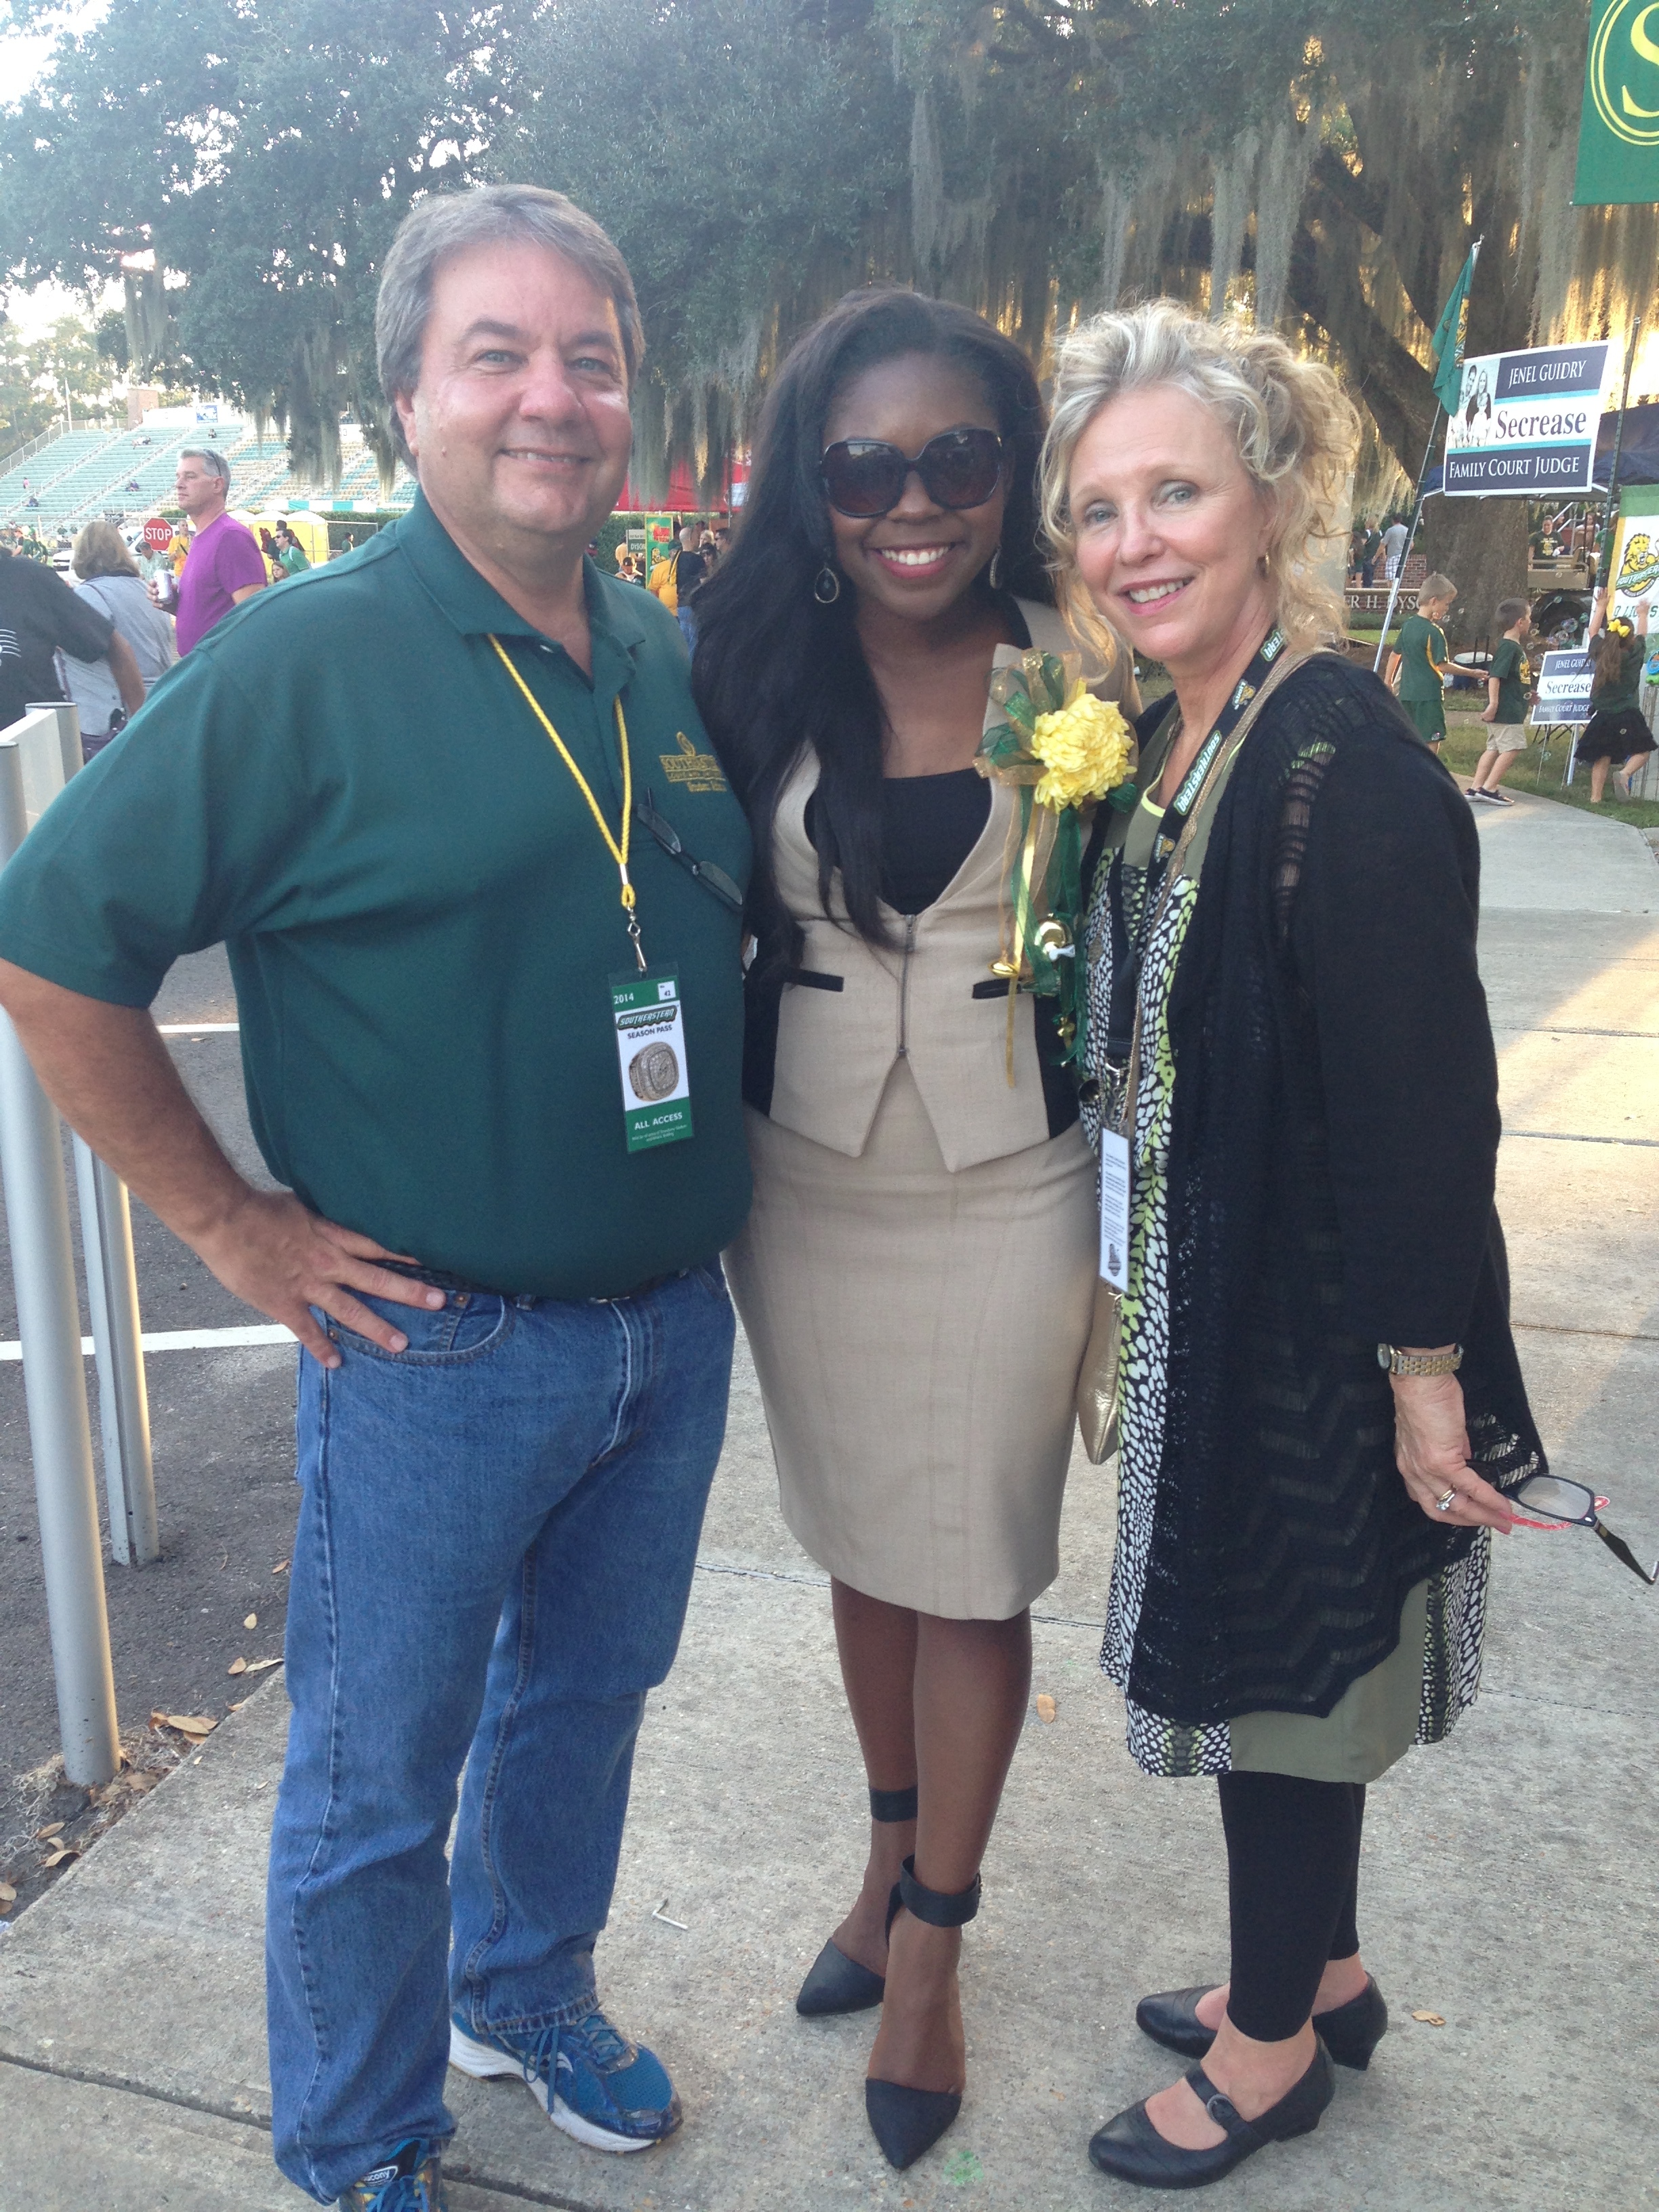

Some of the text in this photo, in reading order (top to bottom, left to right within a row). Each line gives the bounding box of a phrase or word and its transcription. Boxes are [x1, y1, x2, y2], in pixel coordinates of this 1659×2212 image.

[1508, 360, 1587, 388] JENEL GUIDRY
[1495, 411, 1586, 439] Secrease
[1450, 456, 1580, 478] FAMILY COURT JUDGE
[145, 527, 171, 541] STOP
[1555, 659, 1570, 670] JENEL
[1545, 680, 1591, 695] Secrease
[1555, 703, 1572, 712] COURT
[1572, 704, 1589, 713] JUDGE
[1177, 733, 1220, 813] SOUTHEASTERN
[613, 992, 634, 1005] 2014
[619, 1008, 675, 1026] SOUTHEASTERN
[627, 1024, 673, 1040] SEASON PASS
[634, 1112, 683, 1130] ALL ACCESS
